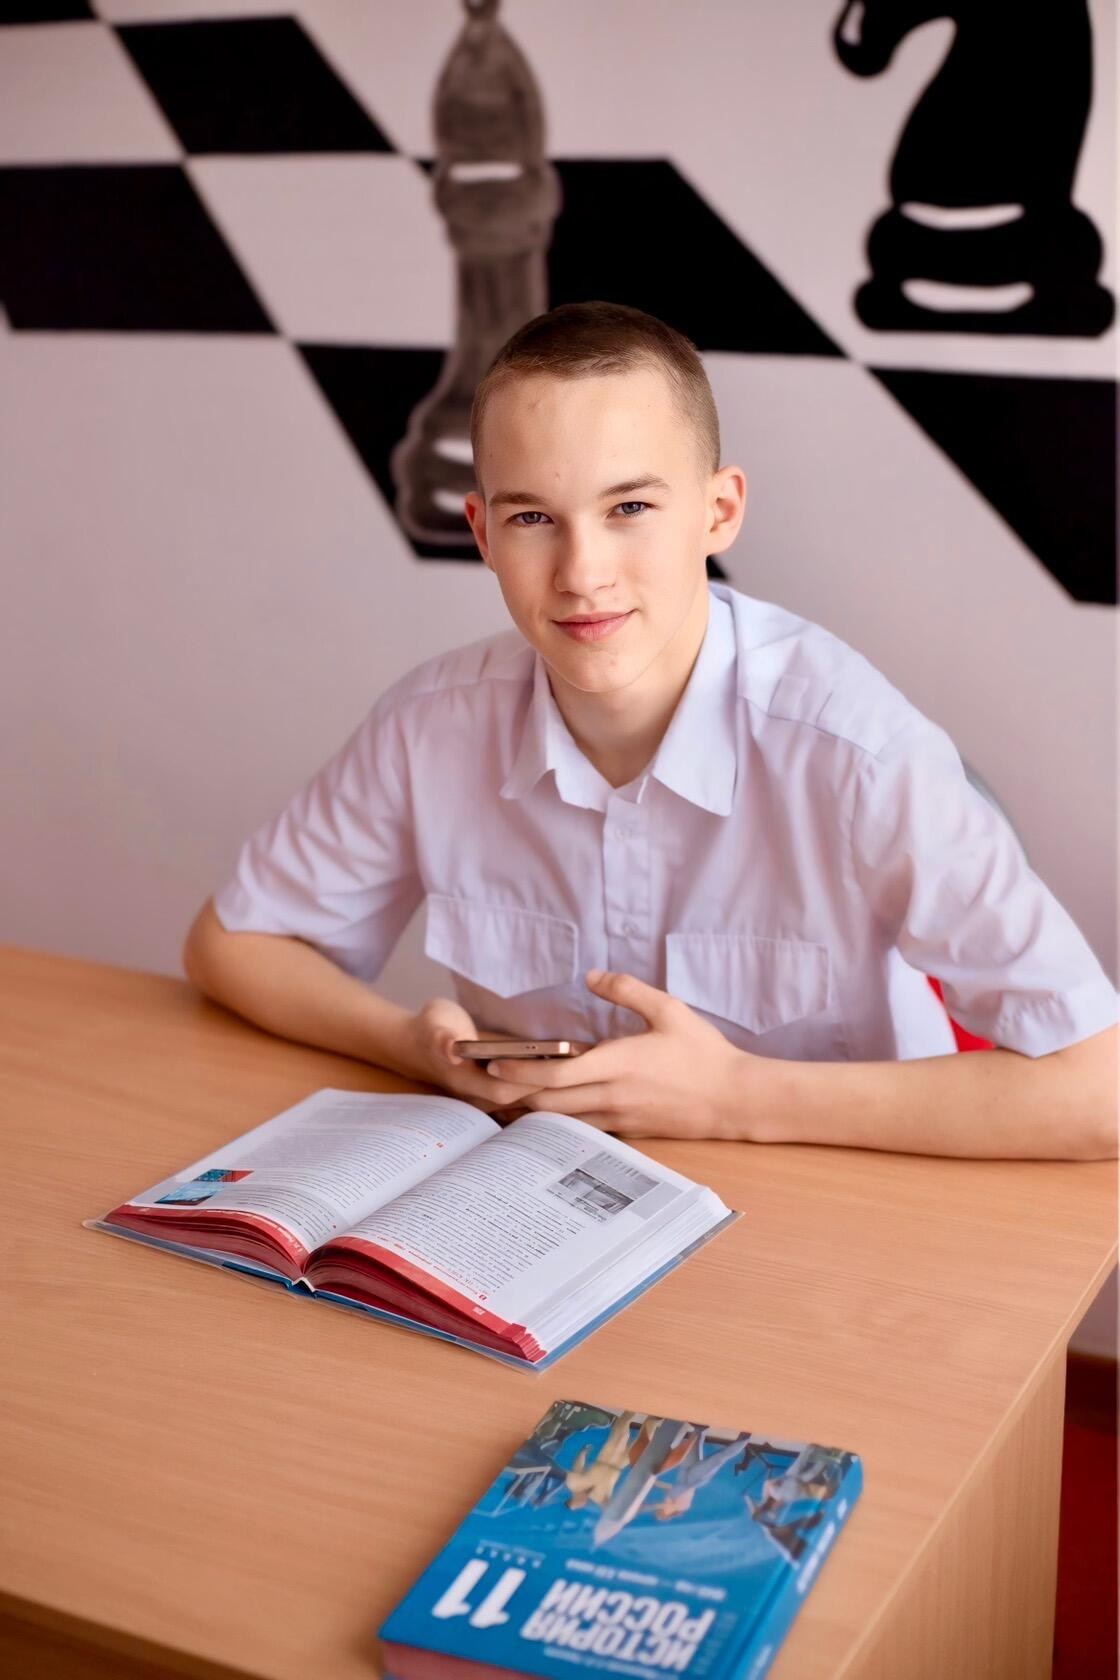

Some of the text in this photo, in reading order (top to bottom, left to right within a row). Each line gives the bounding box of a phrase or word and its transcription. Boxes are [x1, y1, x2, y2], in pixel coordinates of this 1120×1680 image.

[431, 1558, 527, 1628] 11
[539, 1578, 716, 1643] РОССИИ
[520, 1608, 700, 1671] ИСТОРИЯ
